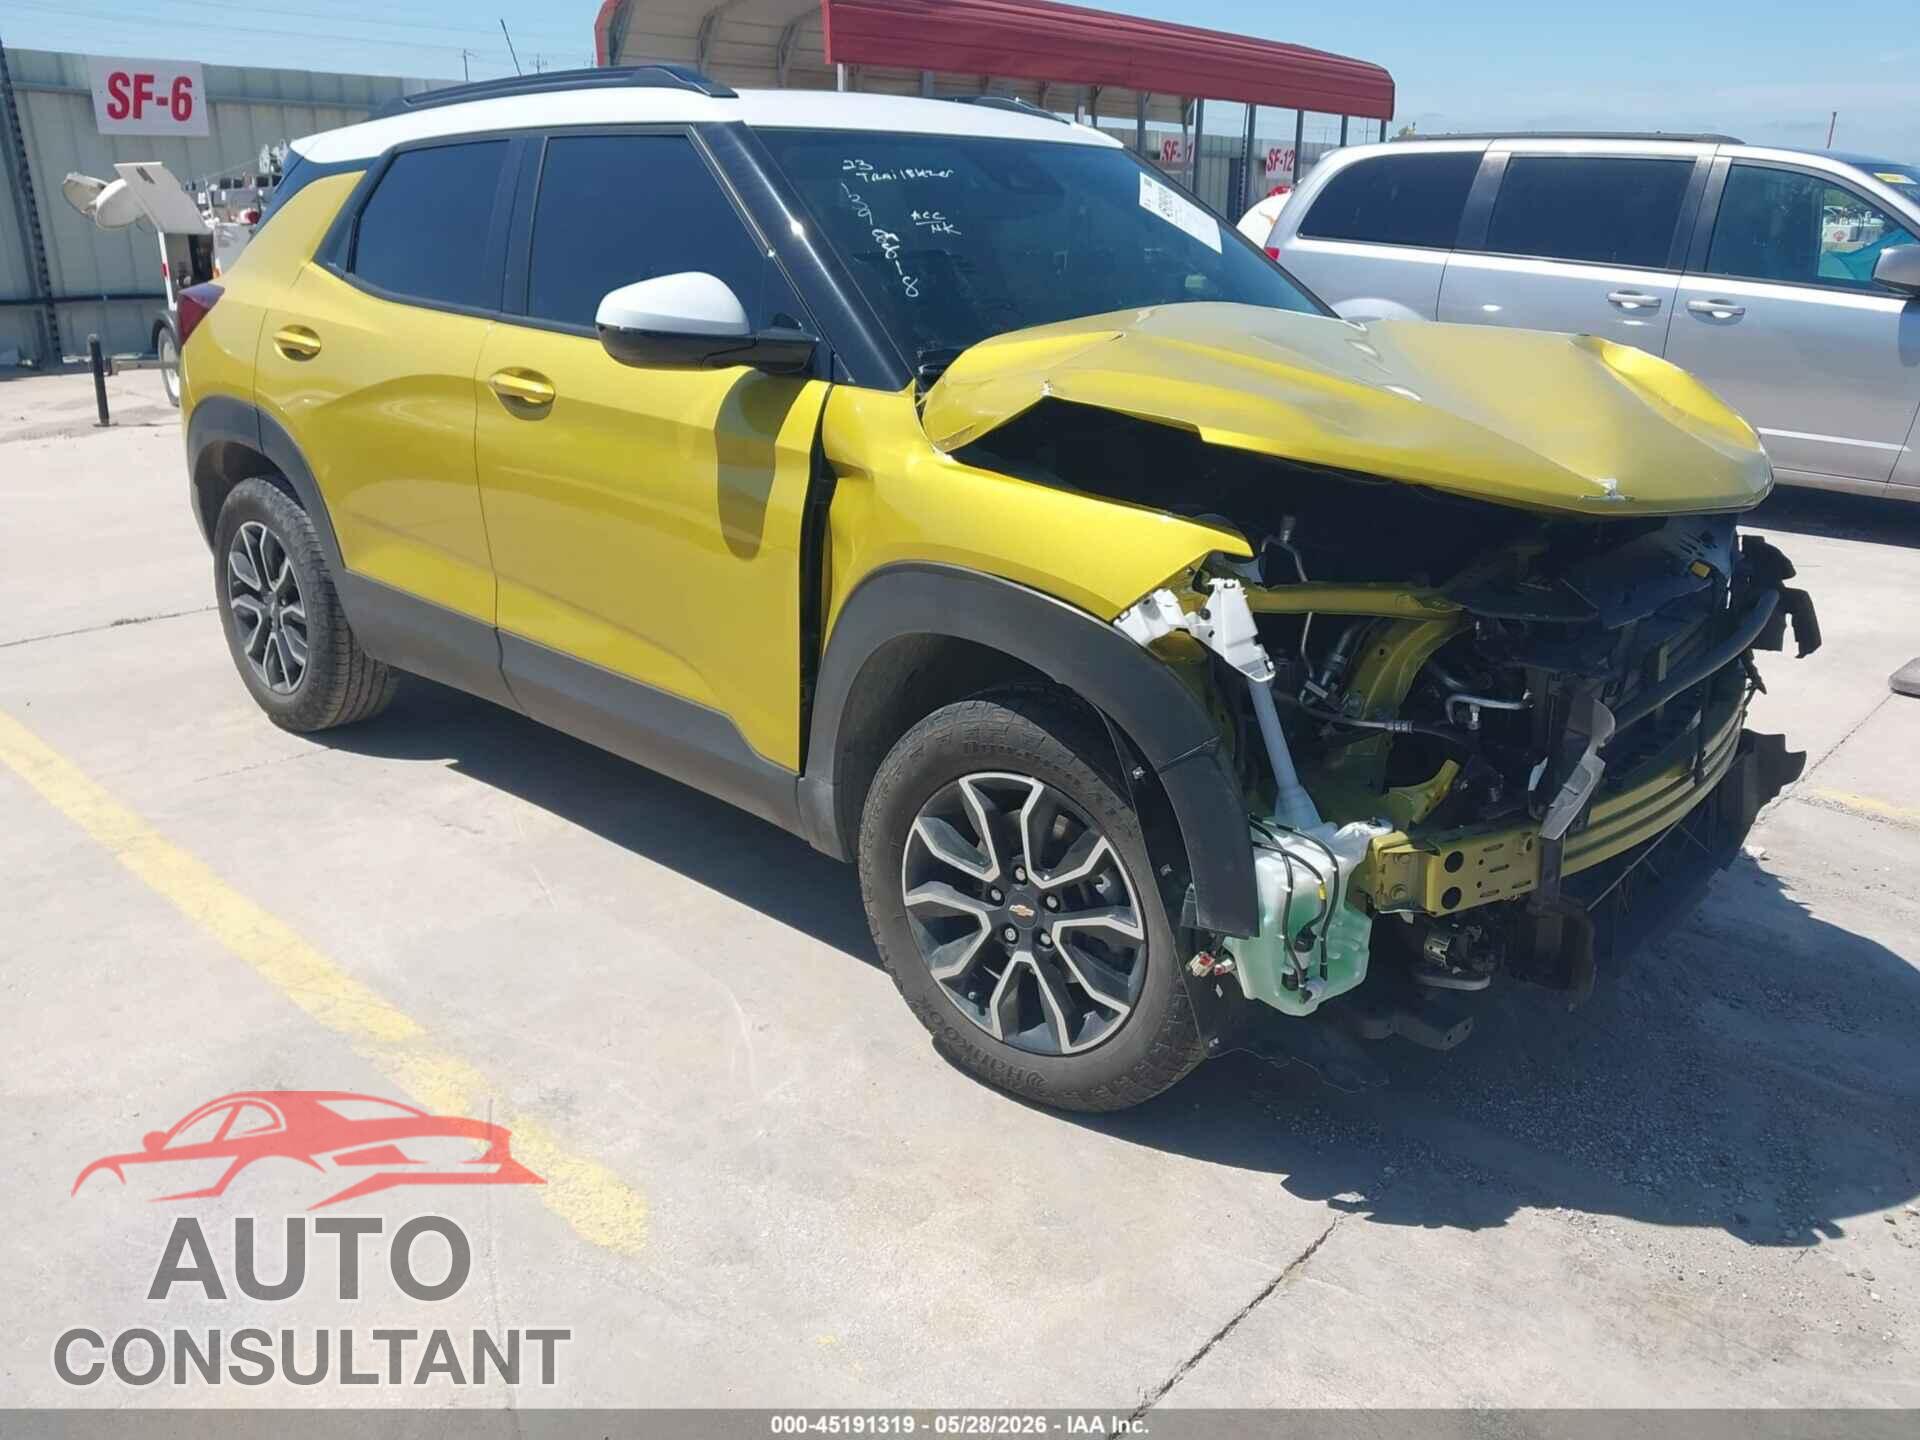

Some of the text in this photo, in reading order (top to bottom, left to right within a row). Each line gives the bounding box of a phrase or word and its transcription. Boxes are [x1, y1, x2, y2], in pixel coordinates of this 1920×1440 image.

[107, 71, 192, 121] SF-6
[842, 159, 874, 171] 23
[1266, 148, 1296, 172] SF-12
